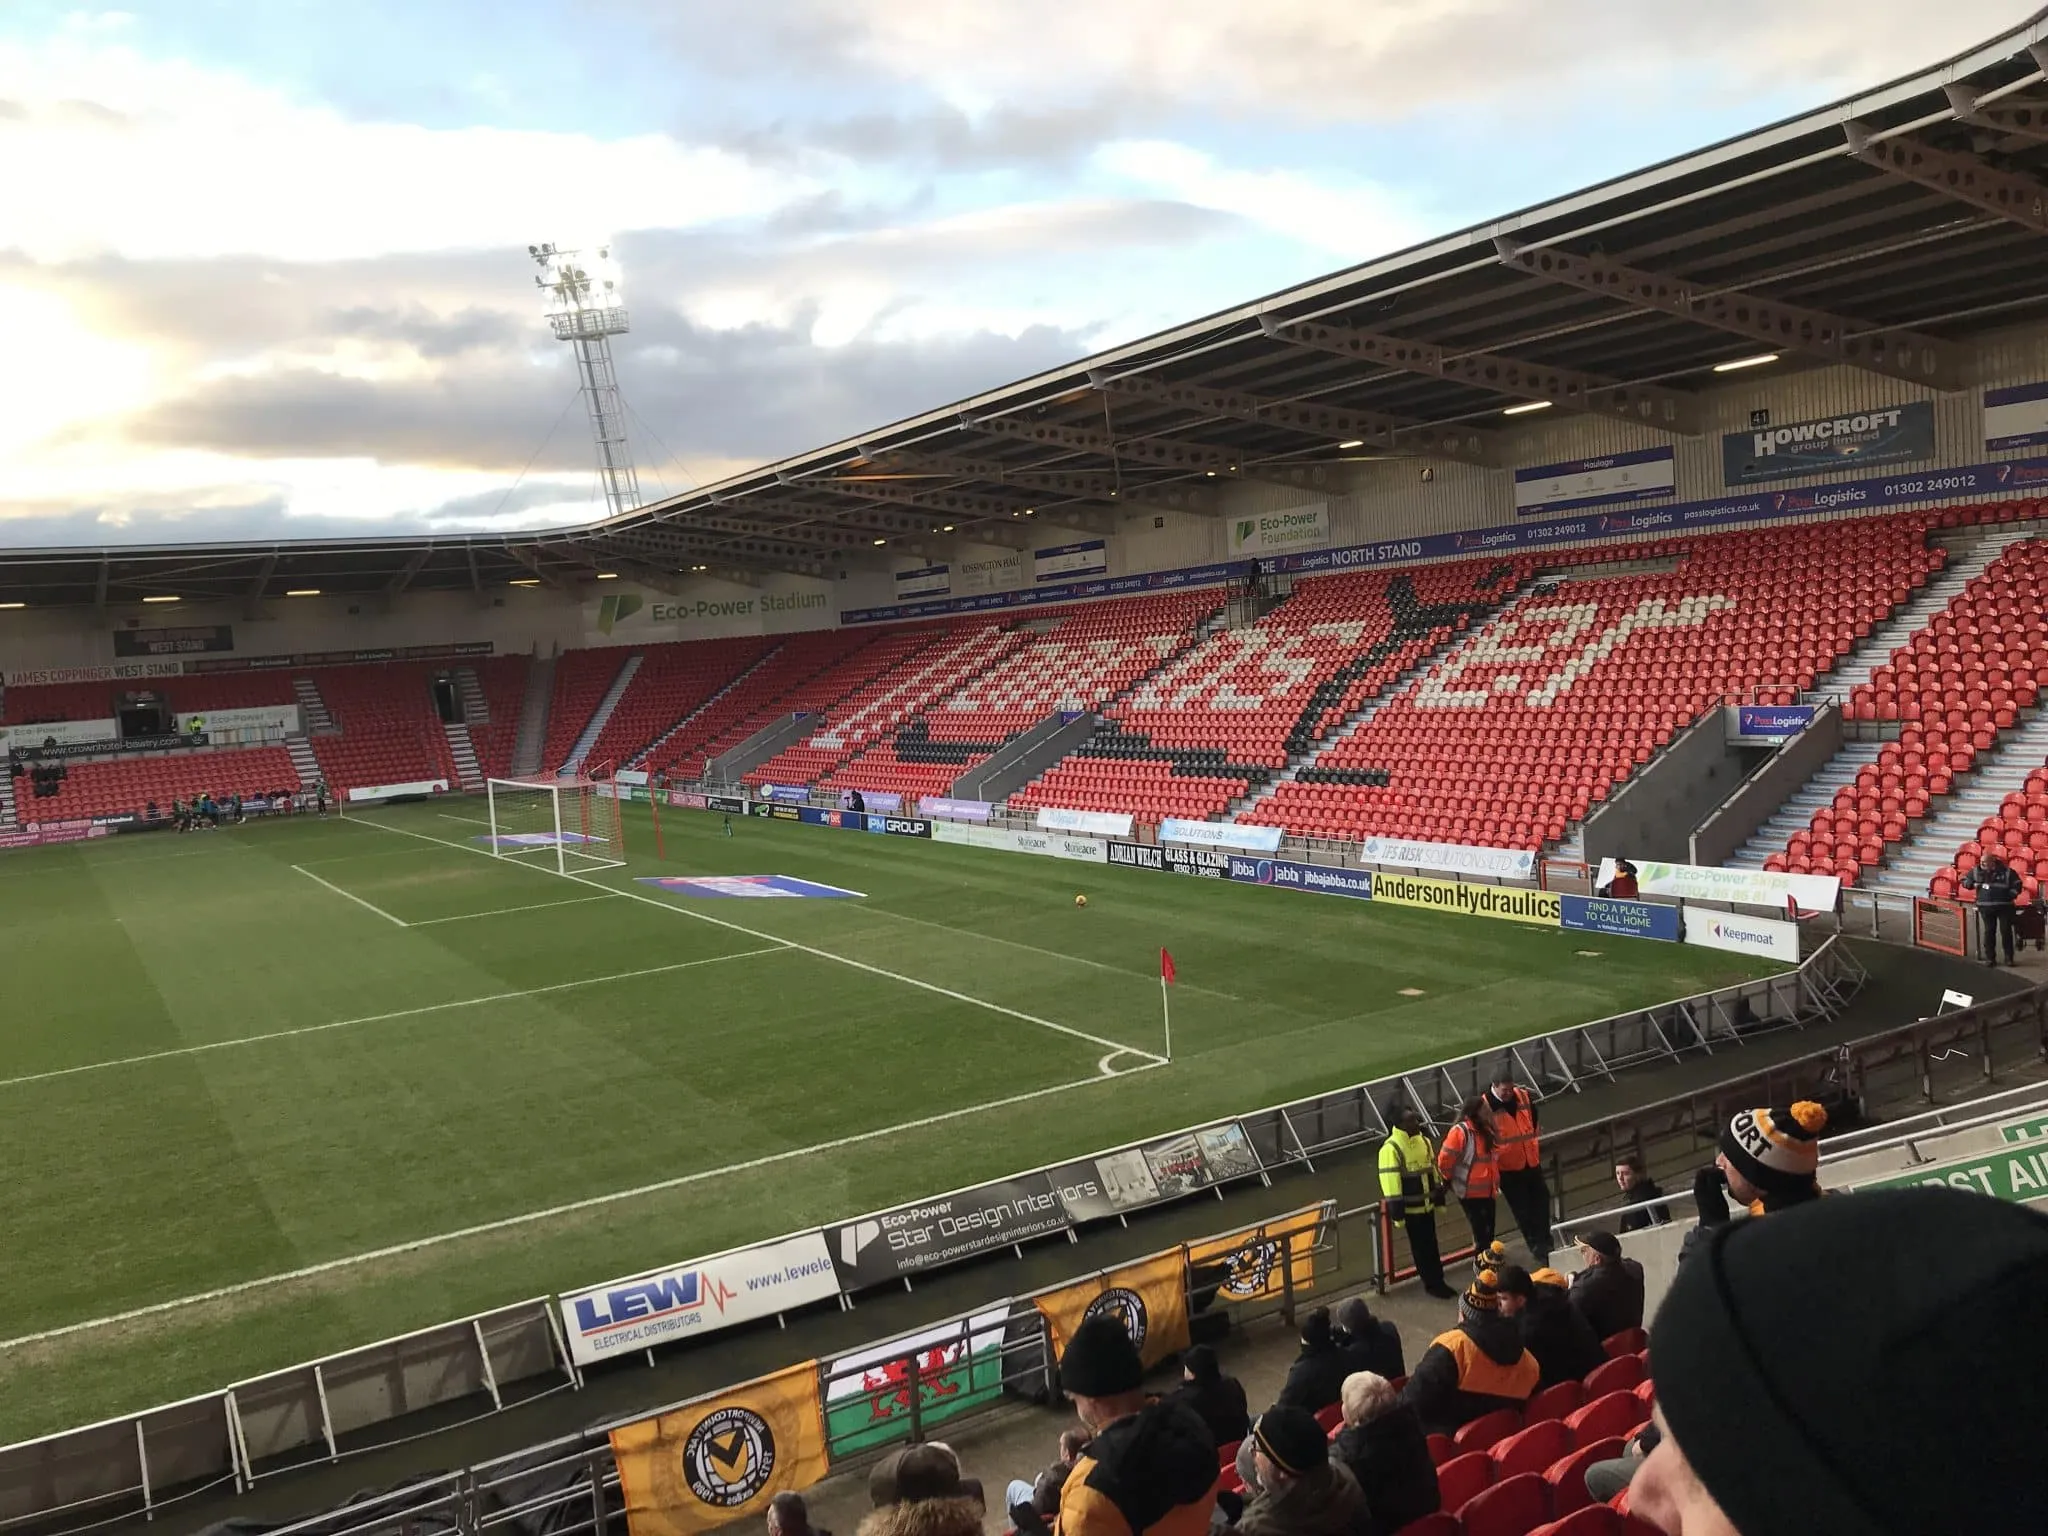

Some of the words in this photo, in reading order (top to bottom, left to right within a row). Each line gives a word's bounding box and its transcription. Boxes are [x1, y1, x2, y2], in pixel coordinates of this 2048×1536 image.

[1752, 412, 1767, 425] 41
[1754, 410, 1902, 457] HOWCROFT
[1791, 438, 1829, 453] group
[1832, 430, 1880, 446] limited
[1584, 458, 1614, 471] Haulage
[1884, 482, 1923, 496] 01302
[1927, 475, 1976, 492] 249012
[1260, 511, 1318, 531] Eco-Power
[1684, 502, 1760, 520] passlogistics.co.uk
[1261, 525, 1320, 545] Foundation
[1528, 527, 1554, 539] 01302
[1555, 523, 1586, 536] 249012
[1258, 559, 1276, 574] HE
[1331, 548, 1375, 565] NORTH
[1378, 542, 1422, 561] STAND
[652, 600, 754, 622] Eco-Power
[760, 591, 827, 612] Stadium
[11, 671, 48, 685] JAMES
[50, 666, 112, 682] COPPINGER
[115, 663, 144, 678] WEST
[147, 662, 179, 676] STAND
[886, 819, 925, 835] GROUP
[1173, 824, 1225, 840] SOLUTIONS
[1110, 843, 1136, 865] ADRIAN
[1137, 846, 1163, 868] WELCH
[1165, 847, 1188, 864] GLASS
[1189, 850, 1195, 864] &
[1196, 851, 1230, 869] GLAZING
[1399, 845, 1424, 862] RISK
[1173, 863, 1190, 874] 01302
[1197, 866, 1221, 879] 304555
[1303, 869, 1371, 892] jibbajabba.co.uk
[1675, 867, 1748, 885] Eco-Power
[1585, 911, 1598, 921] TO
[1599, 913, 1622, 924] CALL
[1623, 916, 1652, 928] HOME
[1588, 902, 1609, 913] FIND
[1611, 904, 1618, 913] A
[1620, 906, 1648, 917] PLACE
[1723, 925, 1773, 946] Keepmoat
[881, 1200, 953, 1230] Eco-Power
[887, 1223, 936, 1251] Star
[939, 1203, 1010, 1238] Design
[1011, 1180, 1098, 1217] Interiors
[574, 1270, 698, 1332] LEW
[746, 1257, 832, 1292] www.lewele
[594, 1327, 644, 1351] ELECTRICAL
[644, 1311, 702, 1337] DISTRIBUTORS
